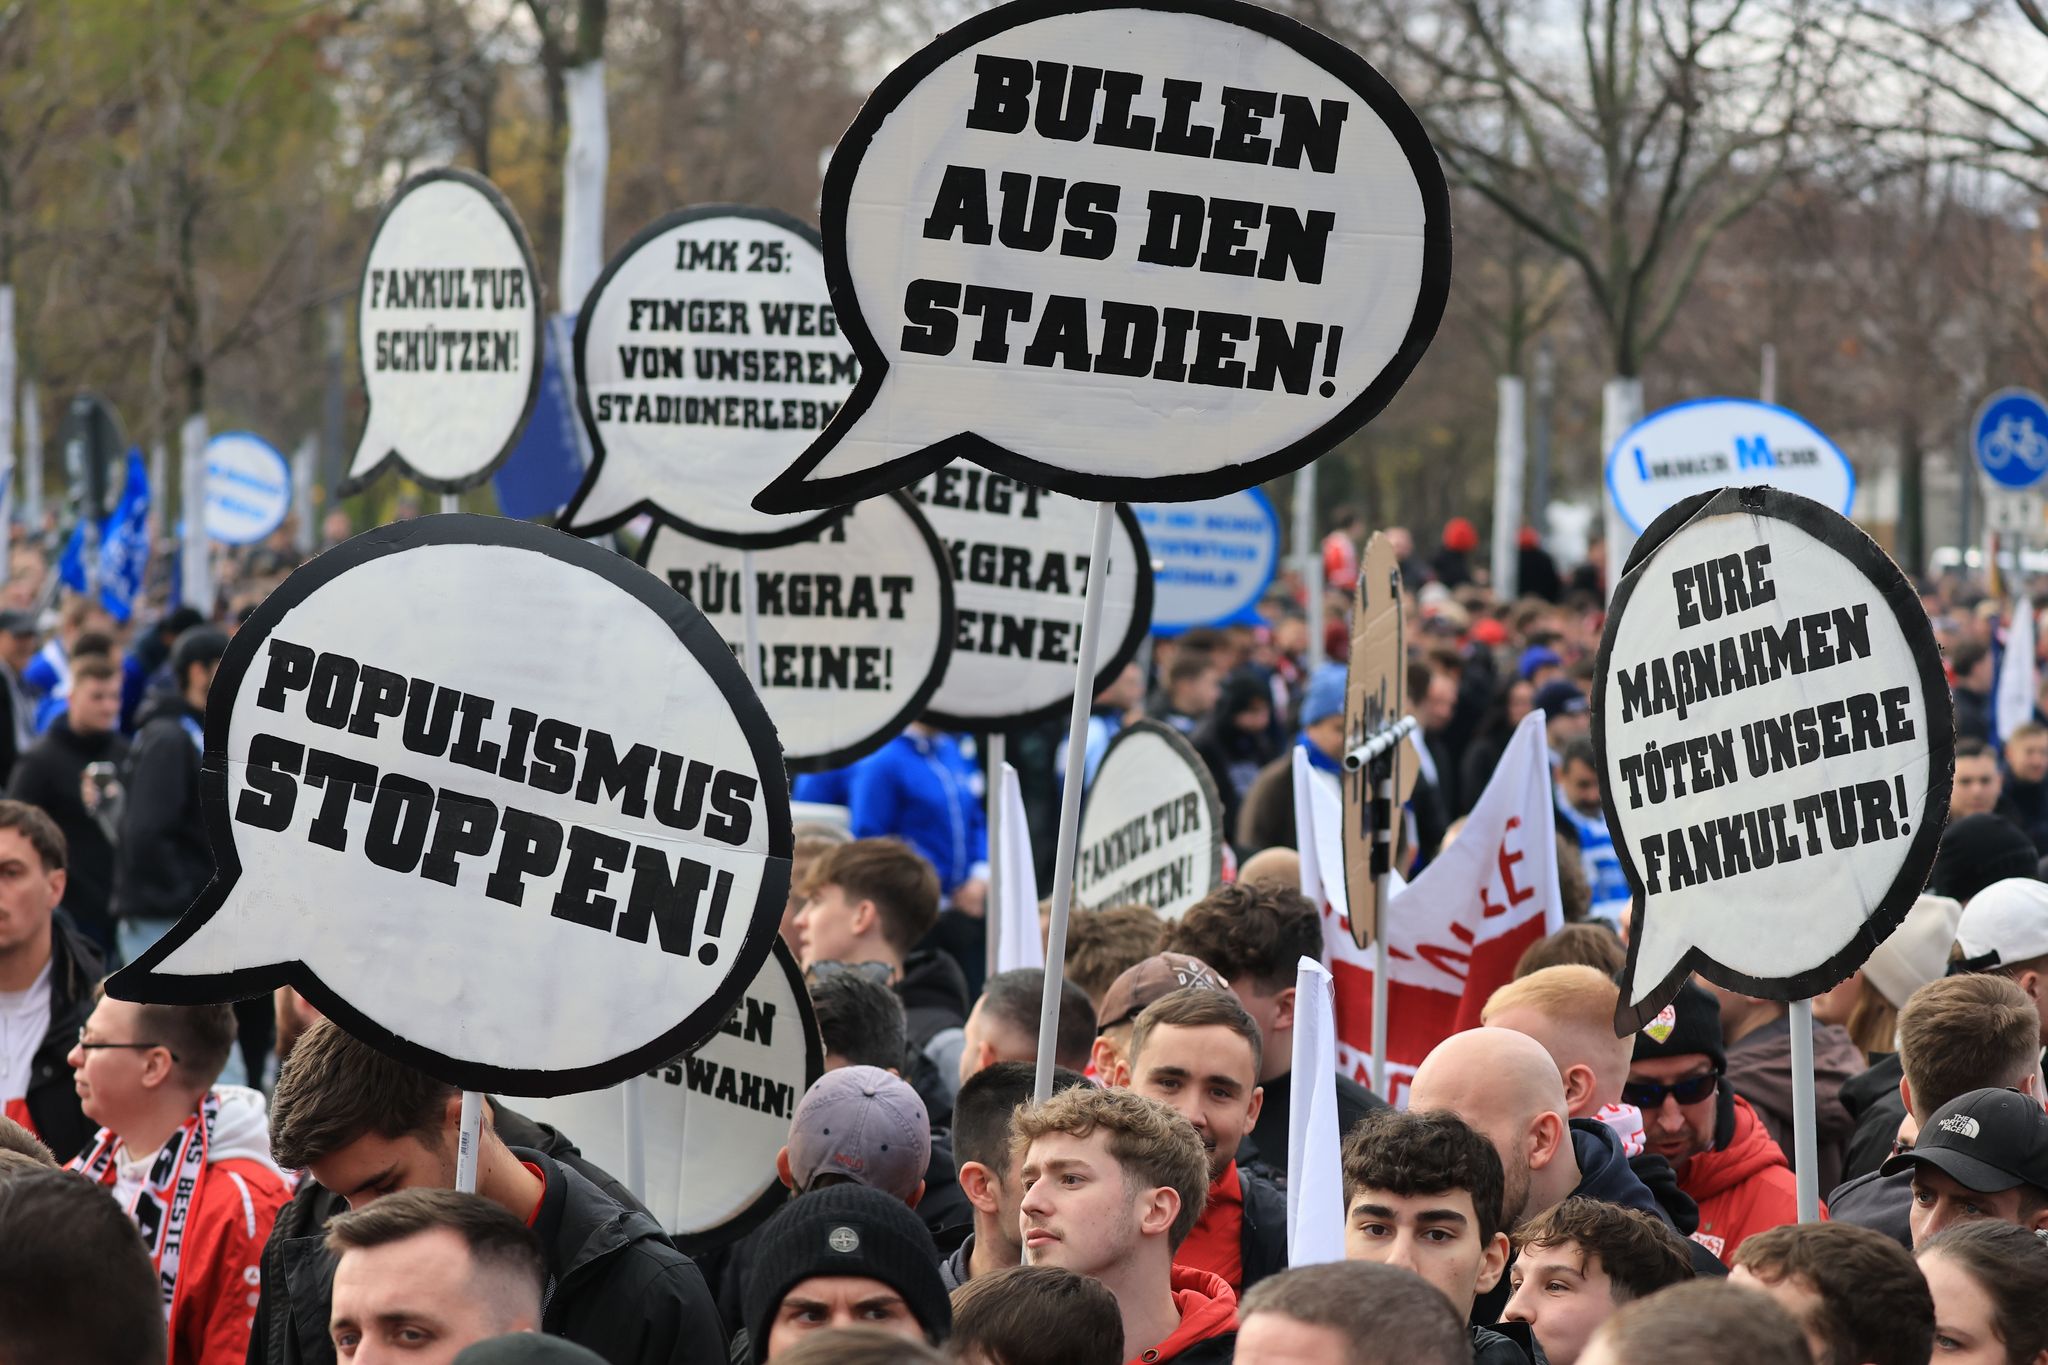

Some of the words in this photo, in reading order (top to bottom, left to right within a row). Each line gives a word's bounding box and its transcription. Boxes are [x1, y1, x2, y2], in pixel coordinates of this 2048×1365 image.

[966, 54, 1349, 174] BULLEN
[675, 240, 739, 272] IMK
[746, 241, 792, 273] 25:
[922, 164, 1121, 260] AUS
[1137, 190, 1336, 284] DEN
[371, 267, 526, 309] FANKULTUR
[628, 299, 750, 335] FINGER
[761, 302, 837, 337] WEG
[375, 323, 519, 372] SCHÜTZEN!
[618, 346, 683, 379] VON
[695, 348, 857, 385] UNSEREM
[900, 278, 1344, 398] STADIEN!
[1672, 543, 1776, 630] EURE
[727, 642, 892, 692] EINE!
[1617, 602, 1872, 724] MAßNAHMEN
[256, 638, 758, 846] POPULISMUS
[1619, 728, 1739, 810] TÖTEN
[1741, 686, 1916, 778] UNSERE
[235, 732, 735, 966] STOPPEN!
[1082, 790, 1200, 892] FANKULTUR
[1639, 774, 1911, 896] FANKULTUR!
[1938, 1118, 1967, 1129] NORTH
[1941, 1124, 1962, 1134] FACE
[1953, 1113, 1970, 1123] THE
[163, 1177, 194, 1256] BESTE
